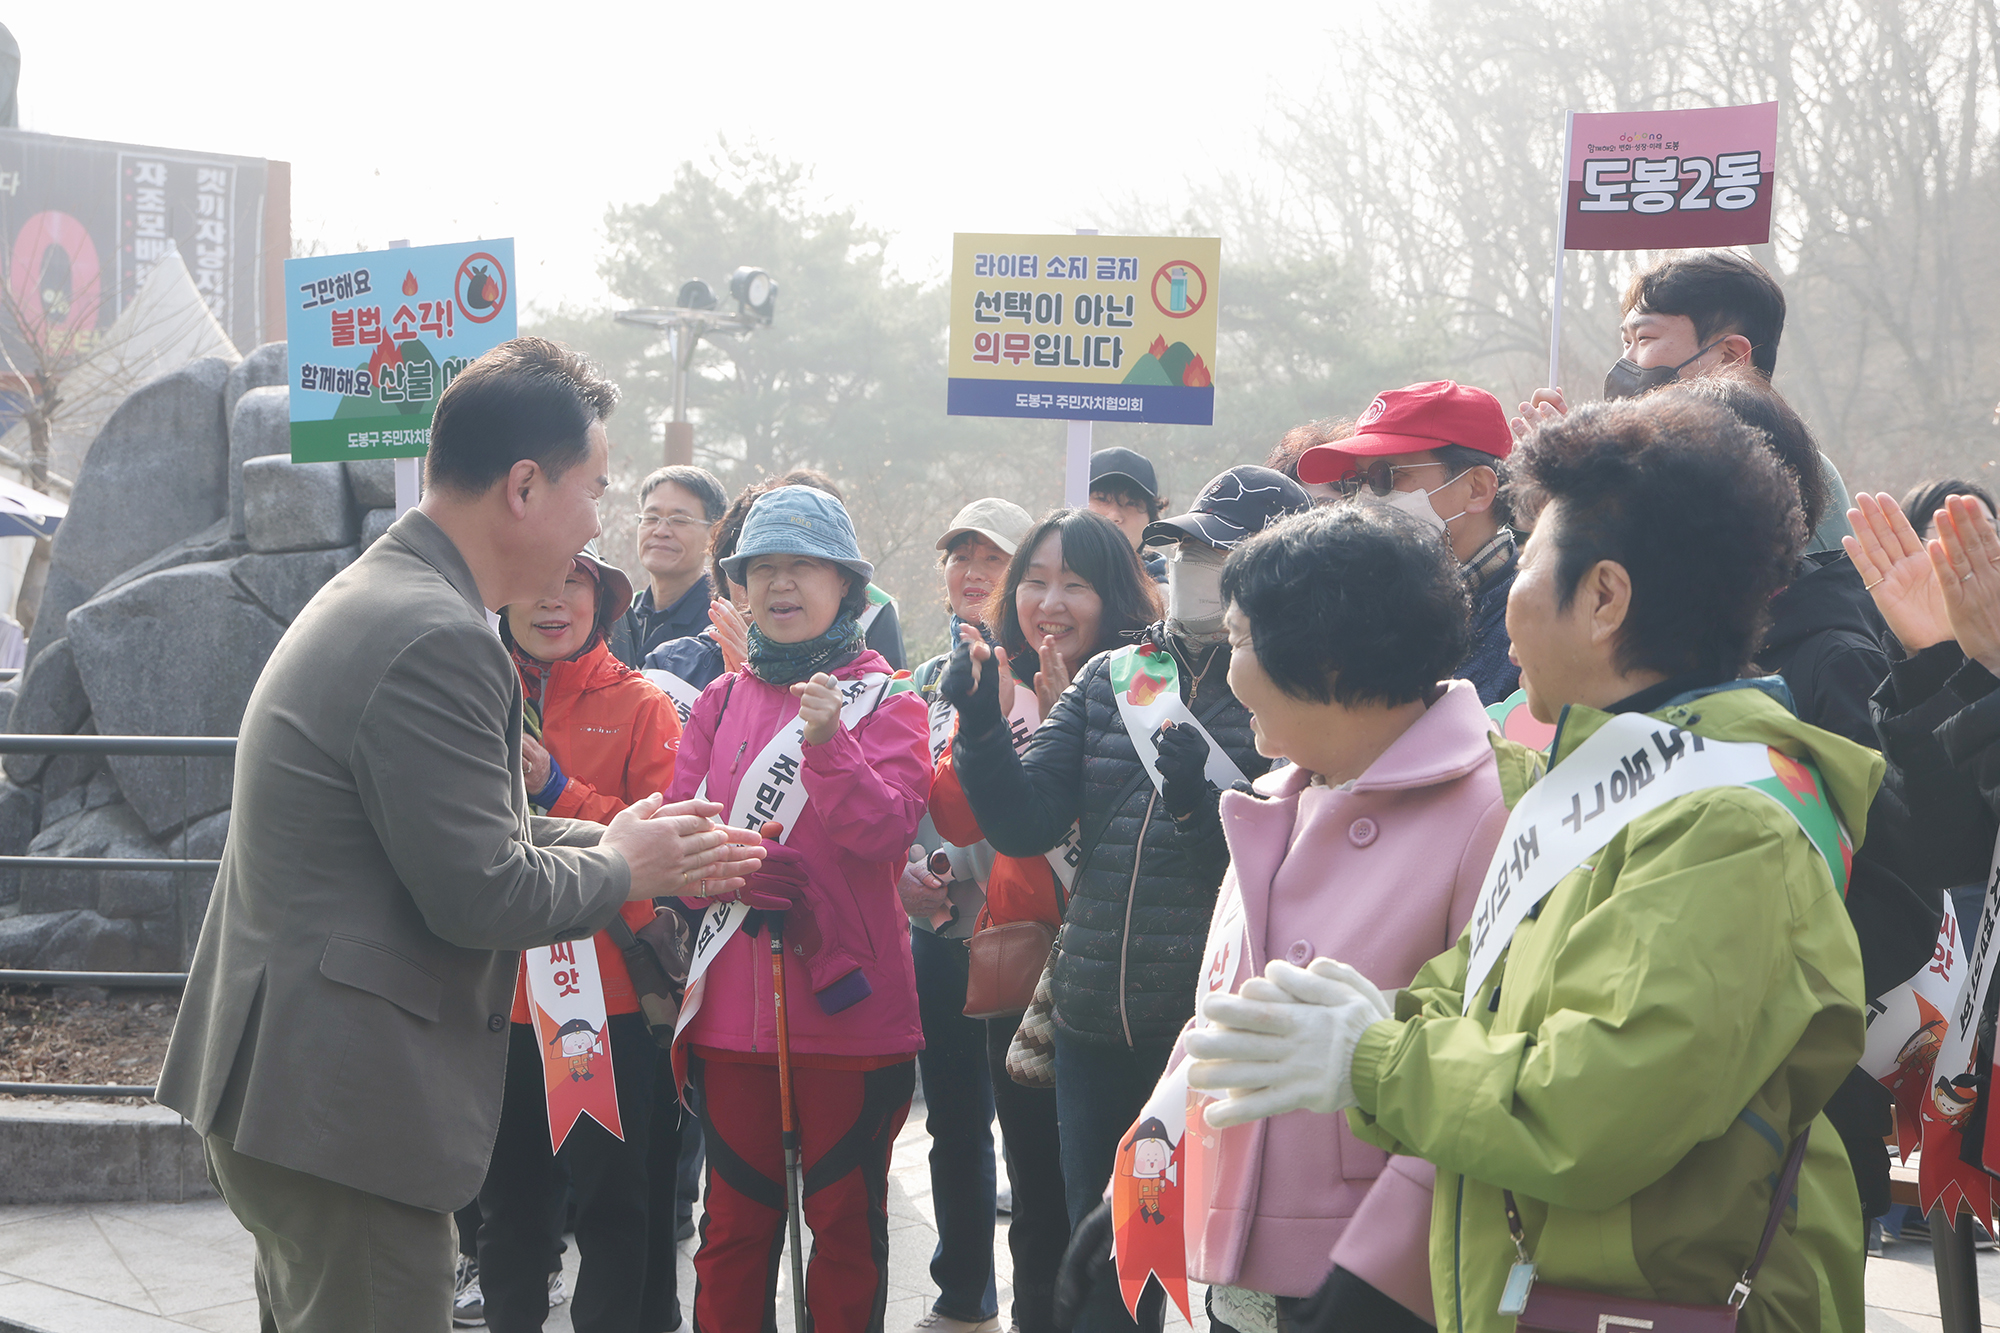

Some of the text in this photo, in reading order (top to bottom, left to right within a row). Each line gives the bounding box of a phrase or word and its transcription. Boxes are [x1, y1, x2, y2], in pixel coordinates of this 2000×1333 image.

[1664, 140, 1680, 151] 도봉
[1578, 150, 1762, 214] 도봉2동
[974, 253, 1138, 281] 라이터 소지 금지
[300, 268, 372, 310] 그만해요
[331, 299, 454, 347] 불법 소각!
[973, 290, 1136, 328] 선택이 아닌
[971, 331, 1125, 369] 의무입니다
[301, 363, 372, 397] 함께해요
[379, 359, 434, 403] 산불
[1015, 393, 1143, 412] 도봉구 주민자치협의회
[348, 431, 380, 448] 도봉구
[790, 516, 812, 528] POLO
[549, 940, 581, 998] 씨앗
